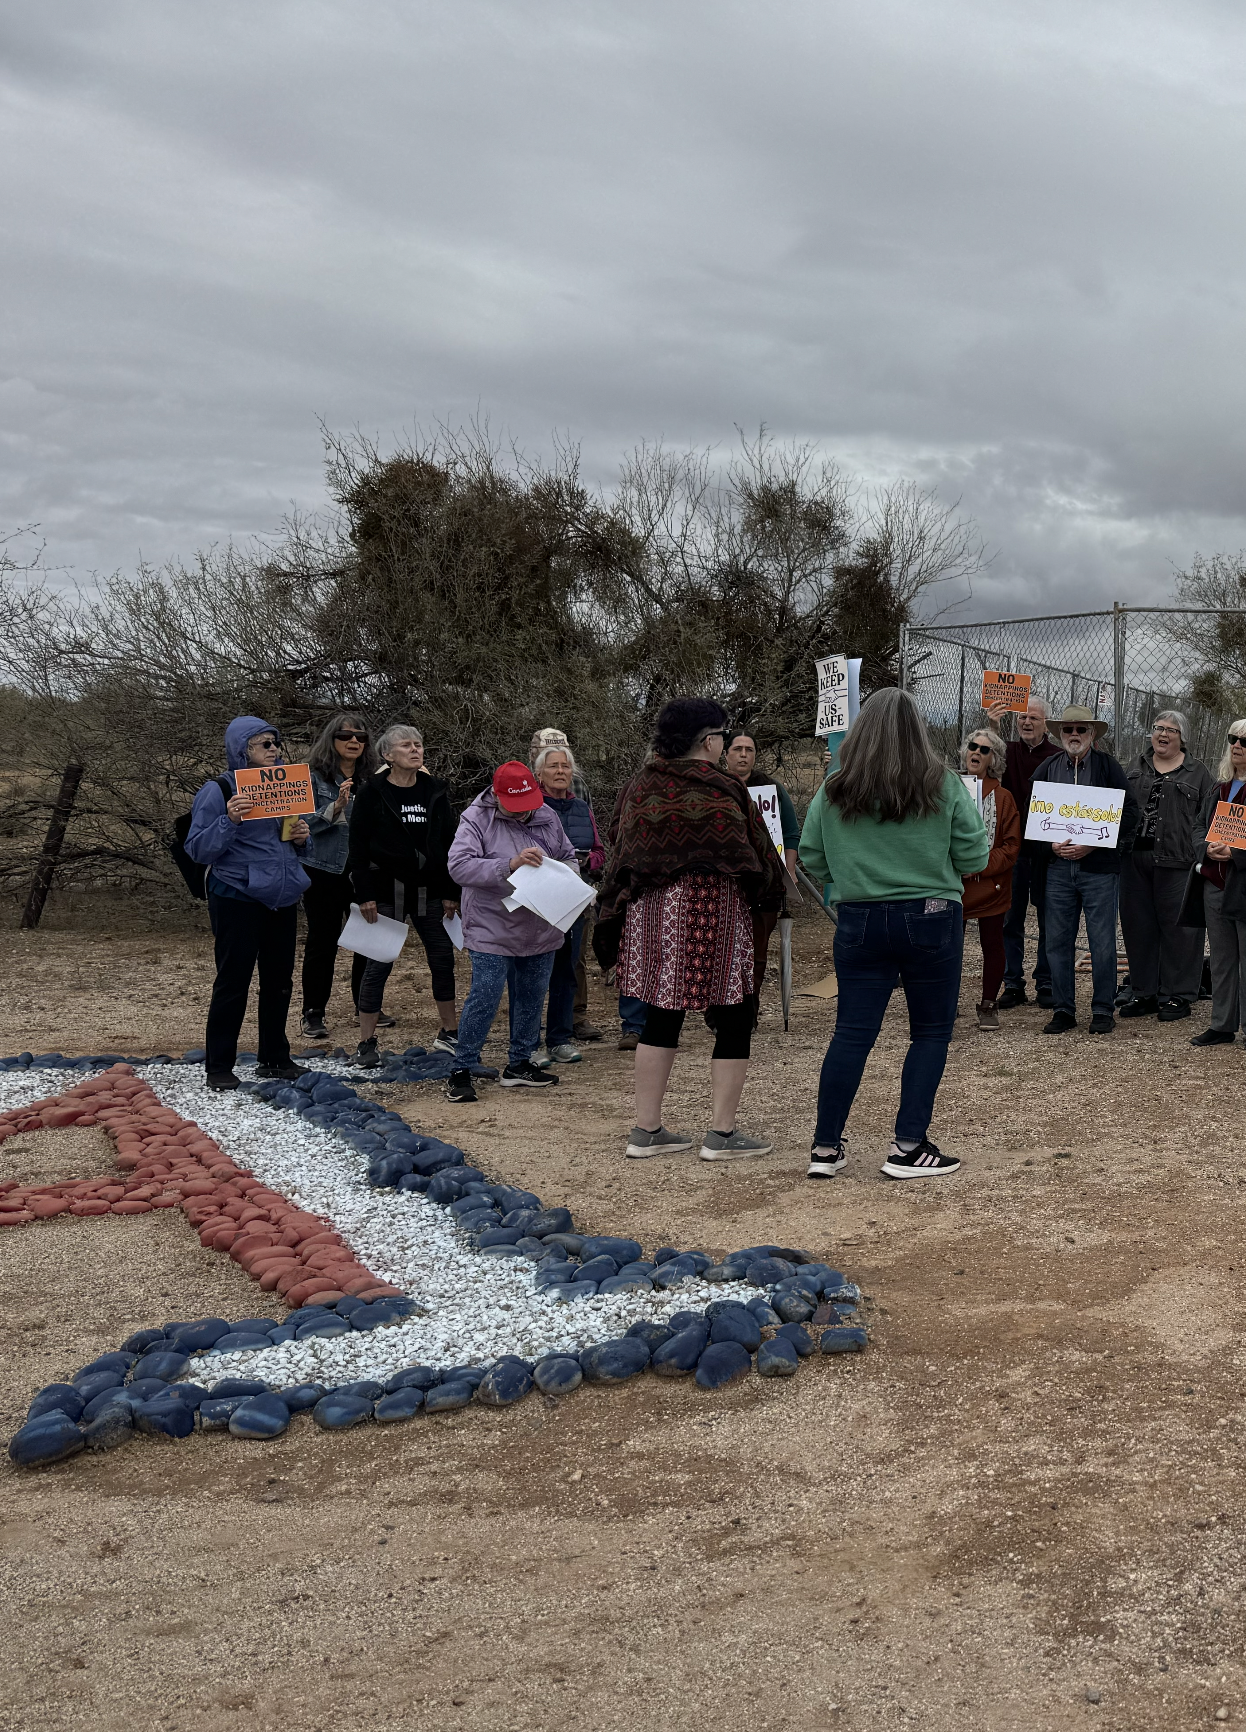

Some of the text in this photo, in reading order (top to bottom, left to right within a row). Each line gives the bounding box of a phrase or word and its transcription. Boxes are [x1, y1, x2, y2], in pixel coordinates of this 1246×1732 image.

[823, 661, 838, 676] WE
[820, 673, 845, 690] KEEP
[998, 674, 1015, 684] NO
[985, 683, 1028, 693] KIDNAPPINGS
[985, 689, 1026, 699] DETENTIONS
[819, 714, 844, 729] SAFE
[260, 768, 287, 783] NO
[241, 780, 308, 793] KIDNAPPINGS
[252, 797, 307, 807] ONCENTRATION
[265, 805, 291, 813] CAMPS
[1229, 804, 1245, 818] NO
